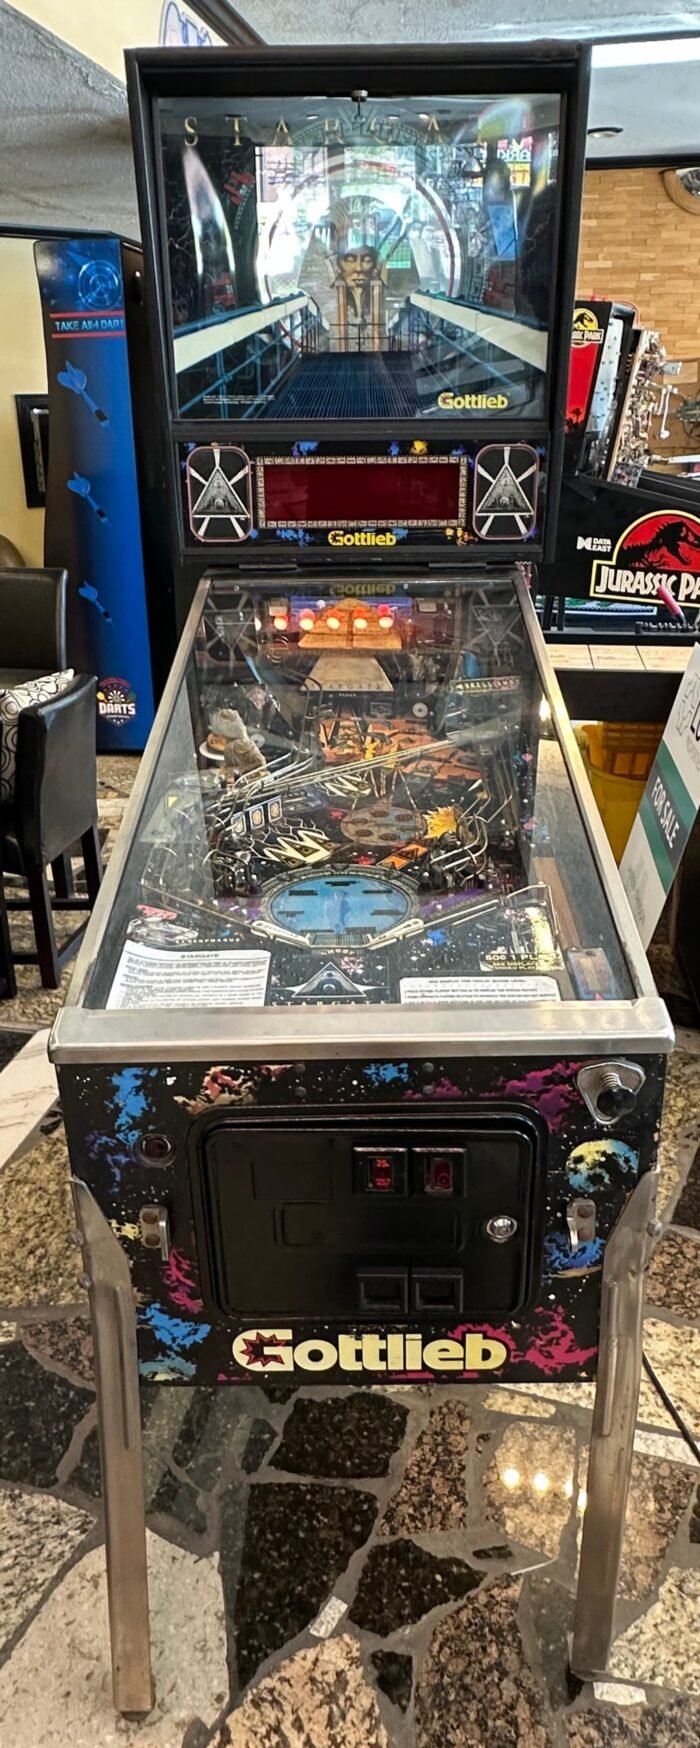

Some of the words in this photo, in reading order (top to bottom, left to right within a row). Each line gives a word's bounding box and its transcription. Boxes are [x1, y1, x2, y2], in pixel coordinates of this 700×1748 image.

[183, 115, 485, 148] STARGA
[55, 321, 79, 331] TAKE
[81, 320, 99, 330] AIM
[437, 392, 508, 409] Gottlieb
[328, 530, 397, 546] Gottlieb
[593, 538, 611, 546] DATA
[595, 565, 677, 597] JURASSIC
[99, 702, 136, 715] DARTS
[650, 775, 665, 815] FOR
[661, 804, 680, 849] SALE
[232, 1328, 508, 1372] Gottlieb
